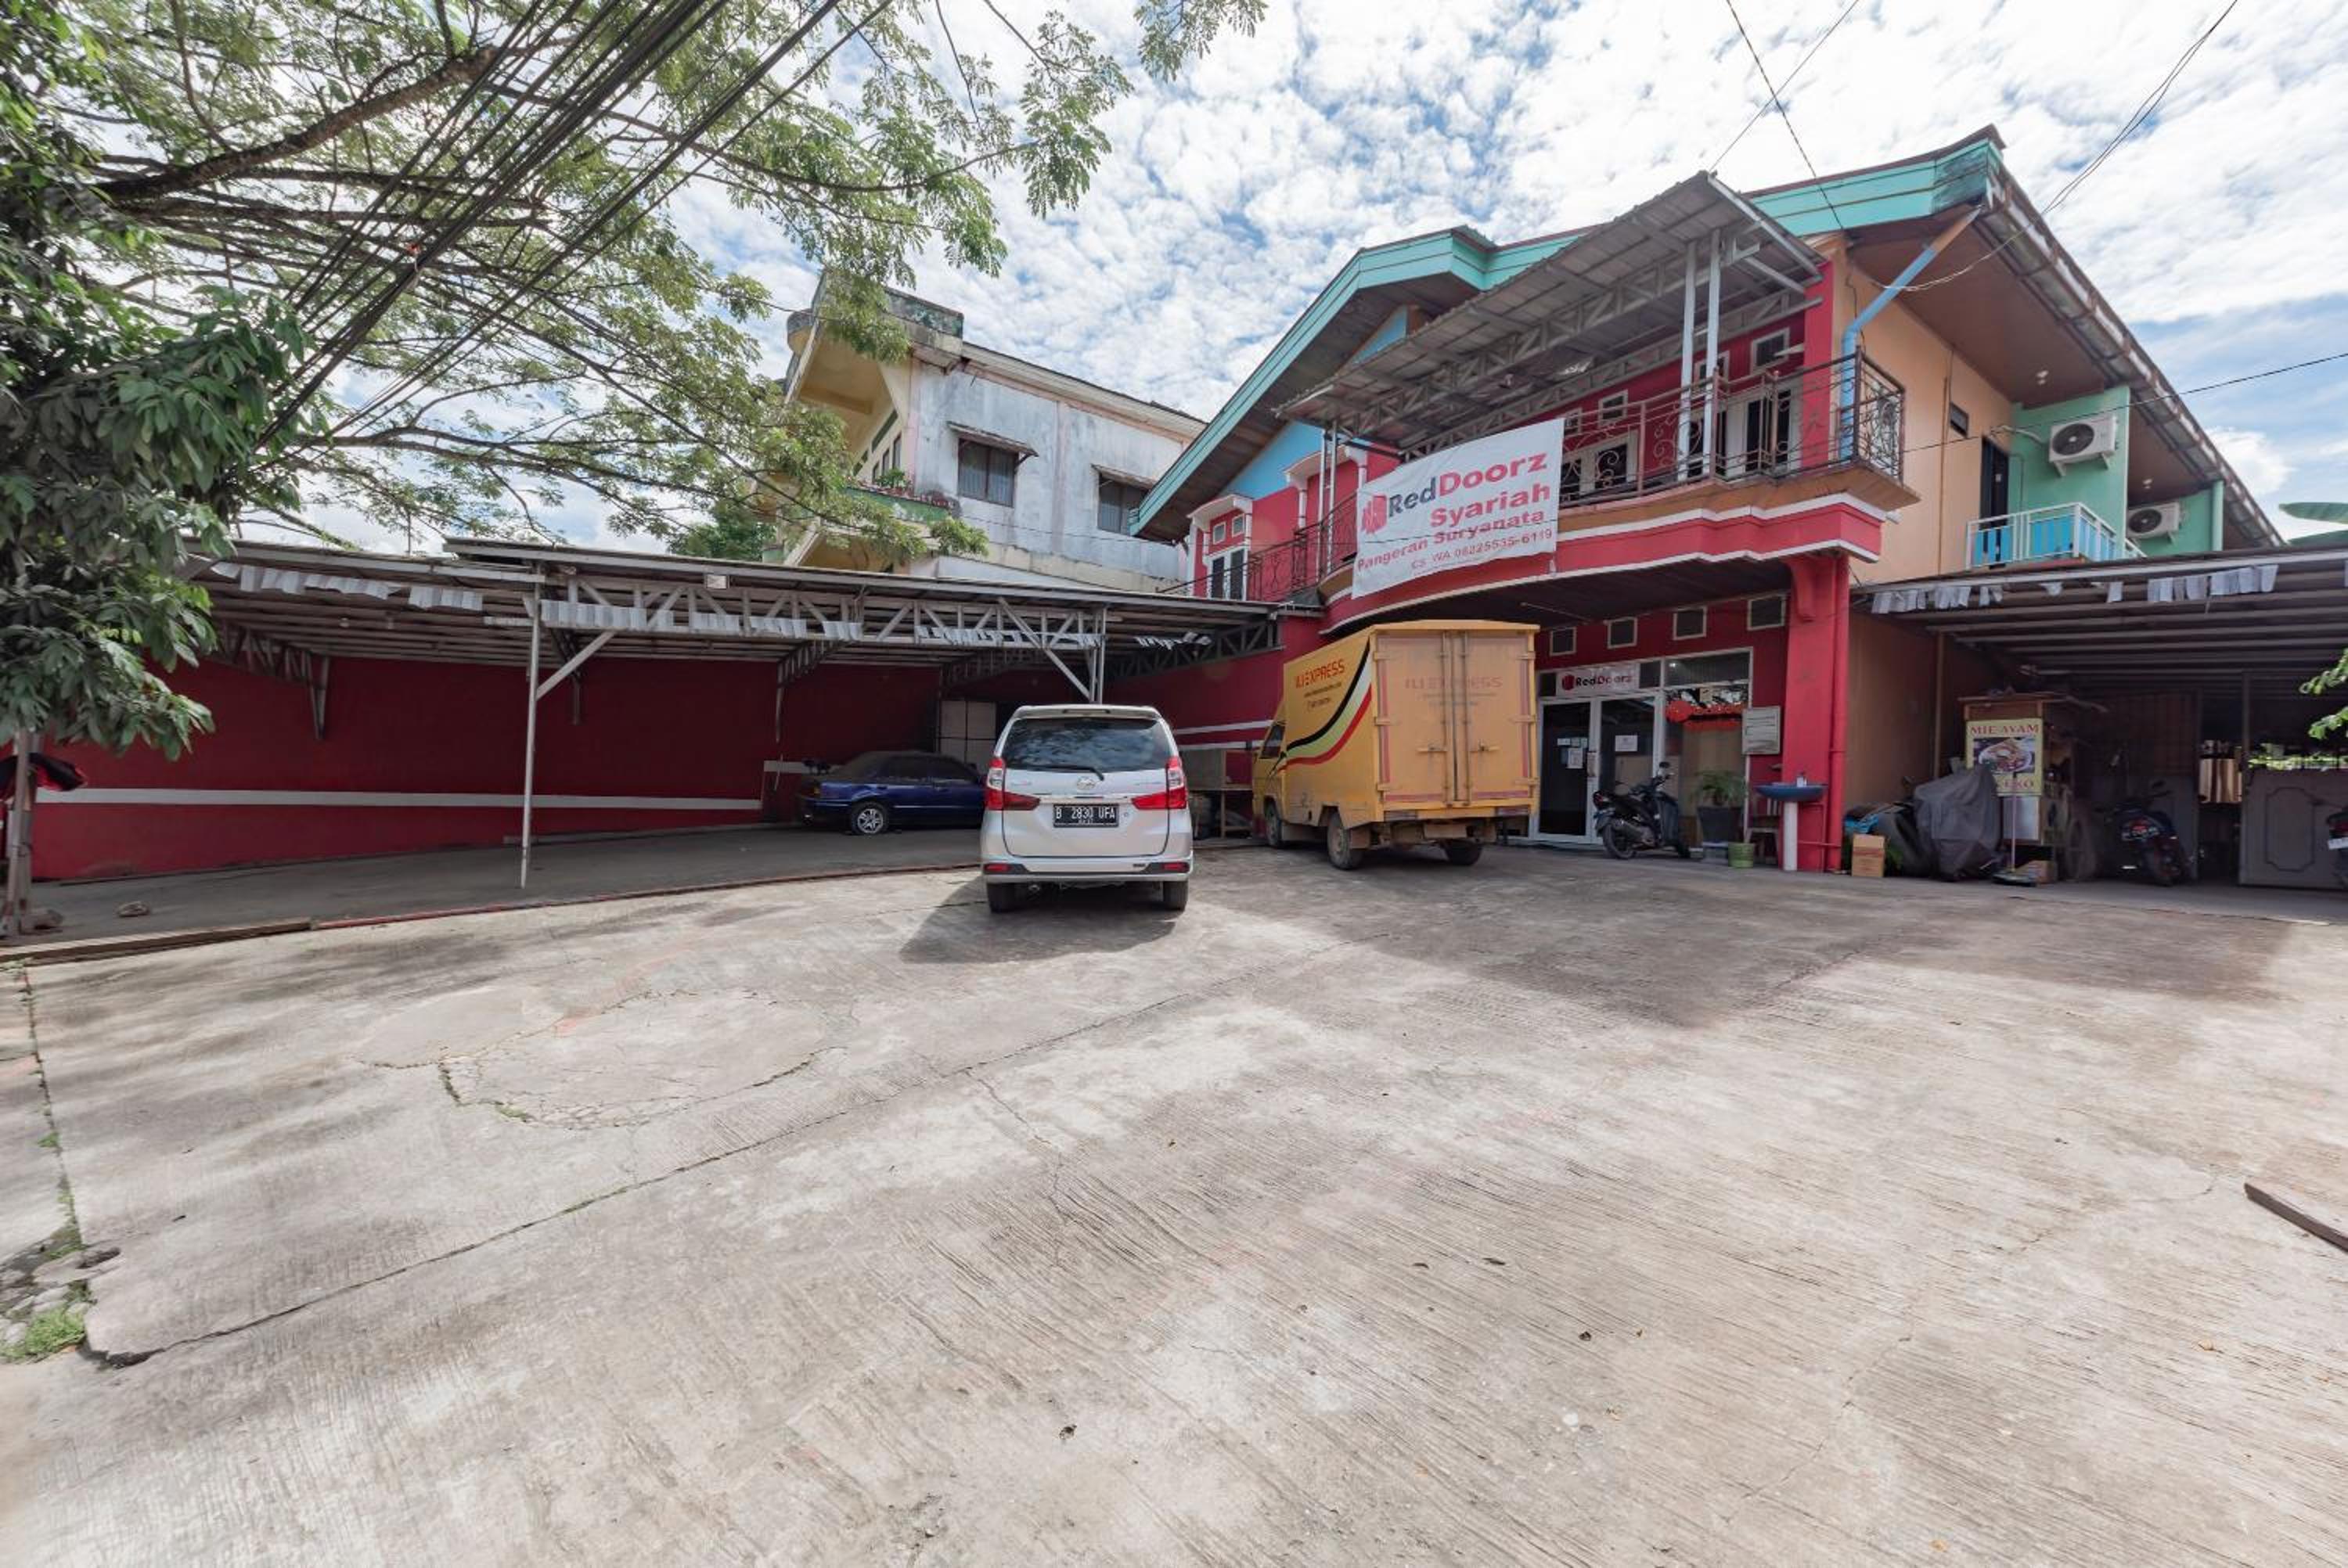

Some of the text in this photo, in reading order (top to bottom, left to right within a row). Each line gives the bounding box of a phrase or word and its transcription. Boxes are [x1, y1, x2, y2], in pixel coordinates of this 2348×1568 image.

[1388, 453, 1547, 517] RedDoorz
[1430, 484, 1550, 527] Syariah
[1358, 511, 1544, 571] Pangeran Suryanata
[1971, 724, 2039, 735] MIE AYAM
[1056, 807, 1062, 819] B
[1098, 807, 1115, 819] UFA
